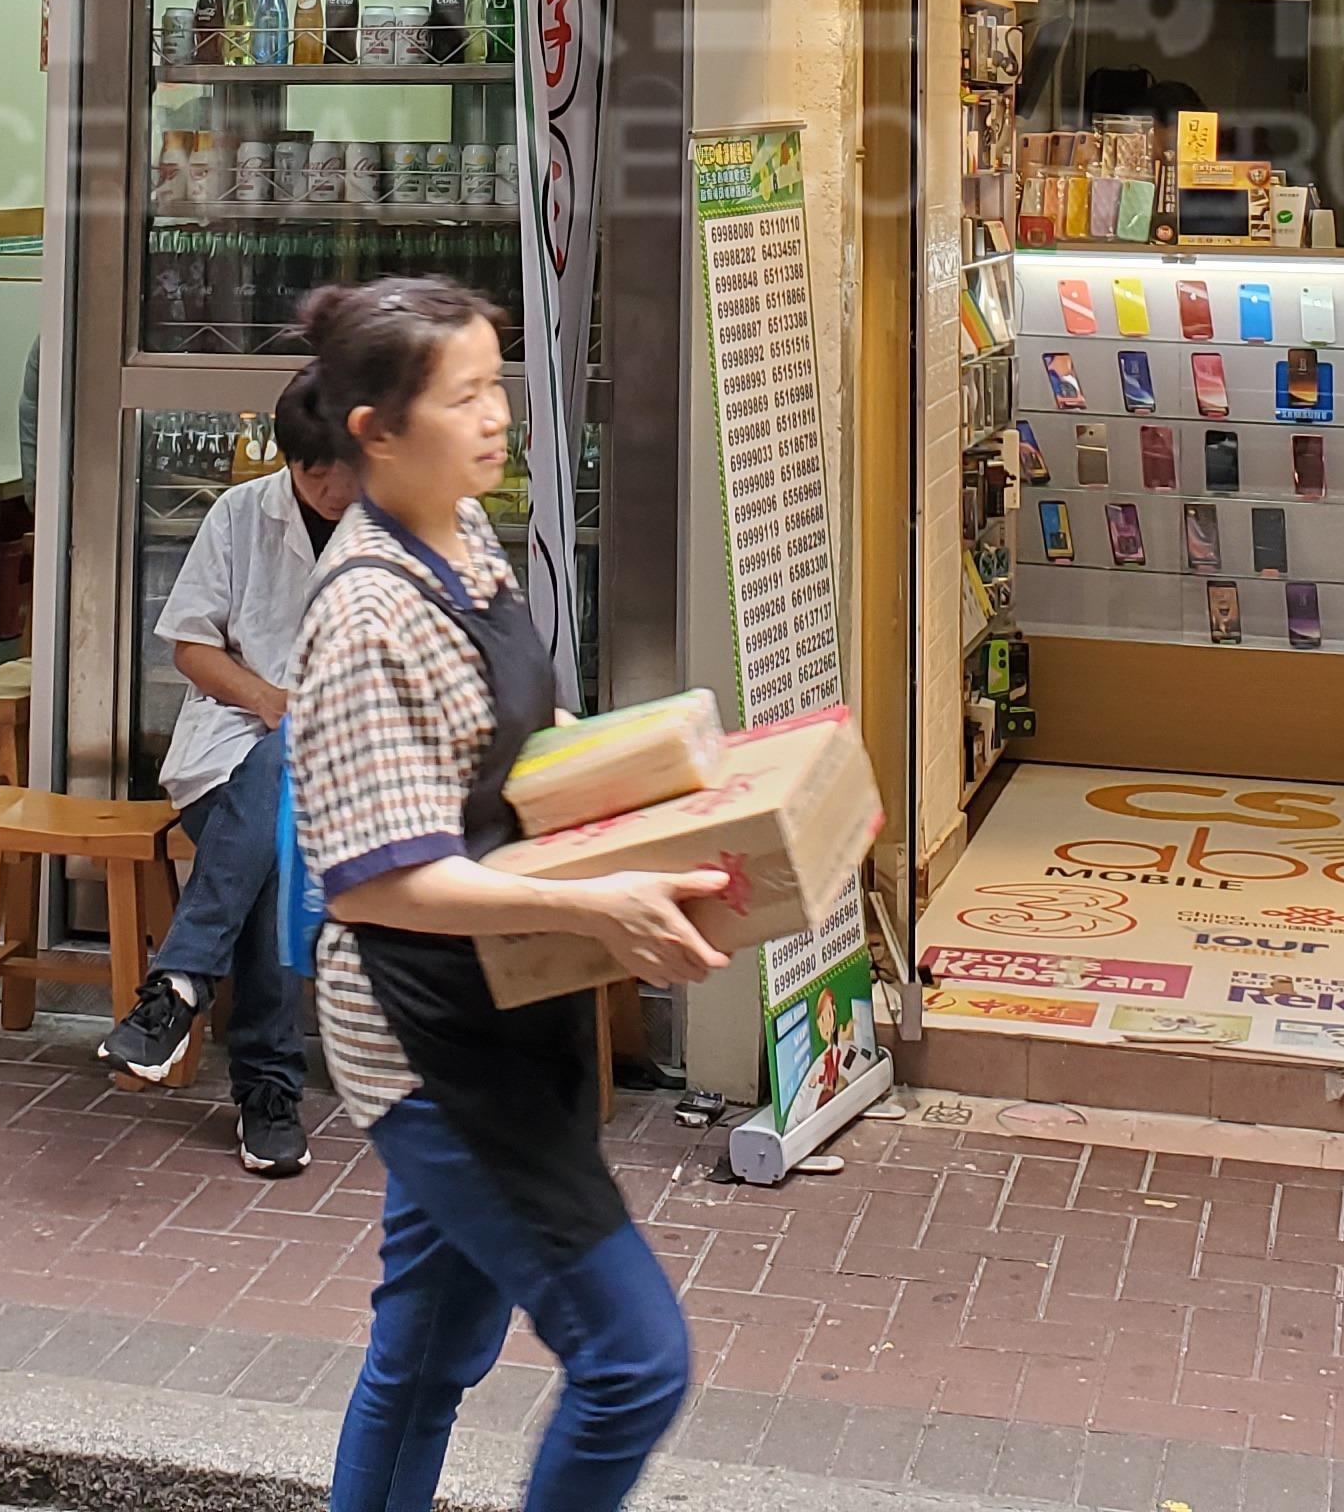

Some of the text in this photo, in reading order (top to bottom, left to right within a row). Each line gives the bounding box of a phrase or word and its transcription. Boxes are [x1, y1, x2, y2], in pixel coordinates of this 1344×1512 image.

[712, 216, 799, 243] 69988080 63110110
[714, 239, 801, 268] 69988282 64334567
[716, 263, 804, 293] 69988848 65113388
[718, 287, 805, 319] 69988886 65118866
[1045, 867, 1245, 891] MOBILE
[775, 926, 860, 996] 69999980 69969996
[933, 959, 1167, 992] Kabayan
